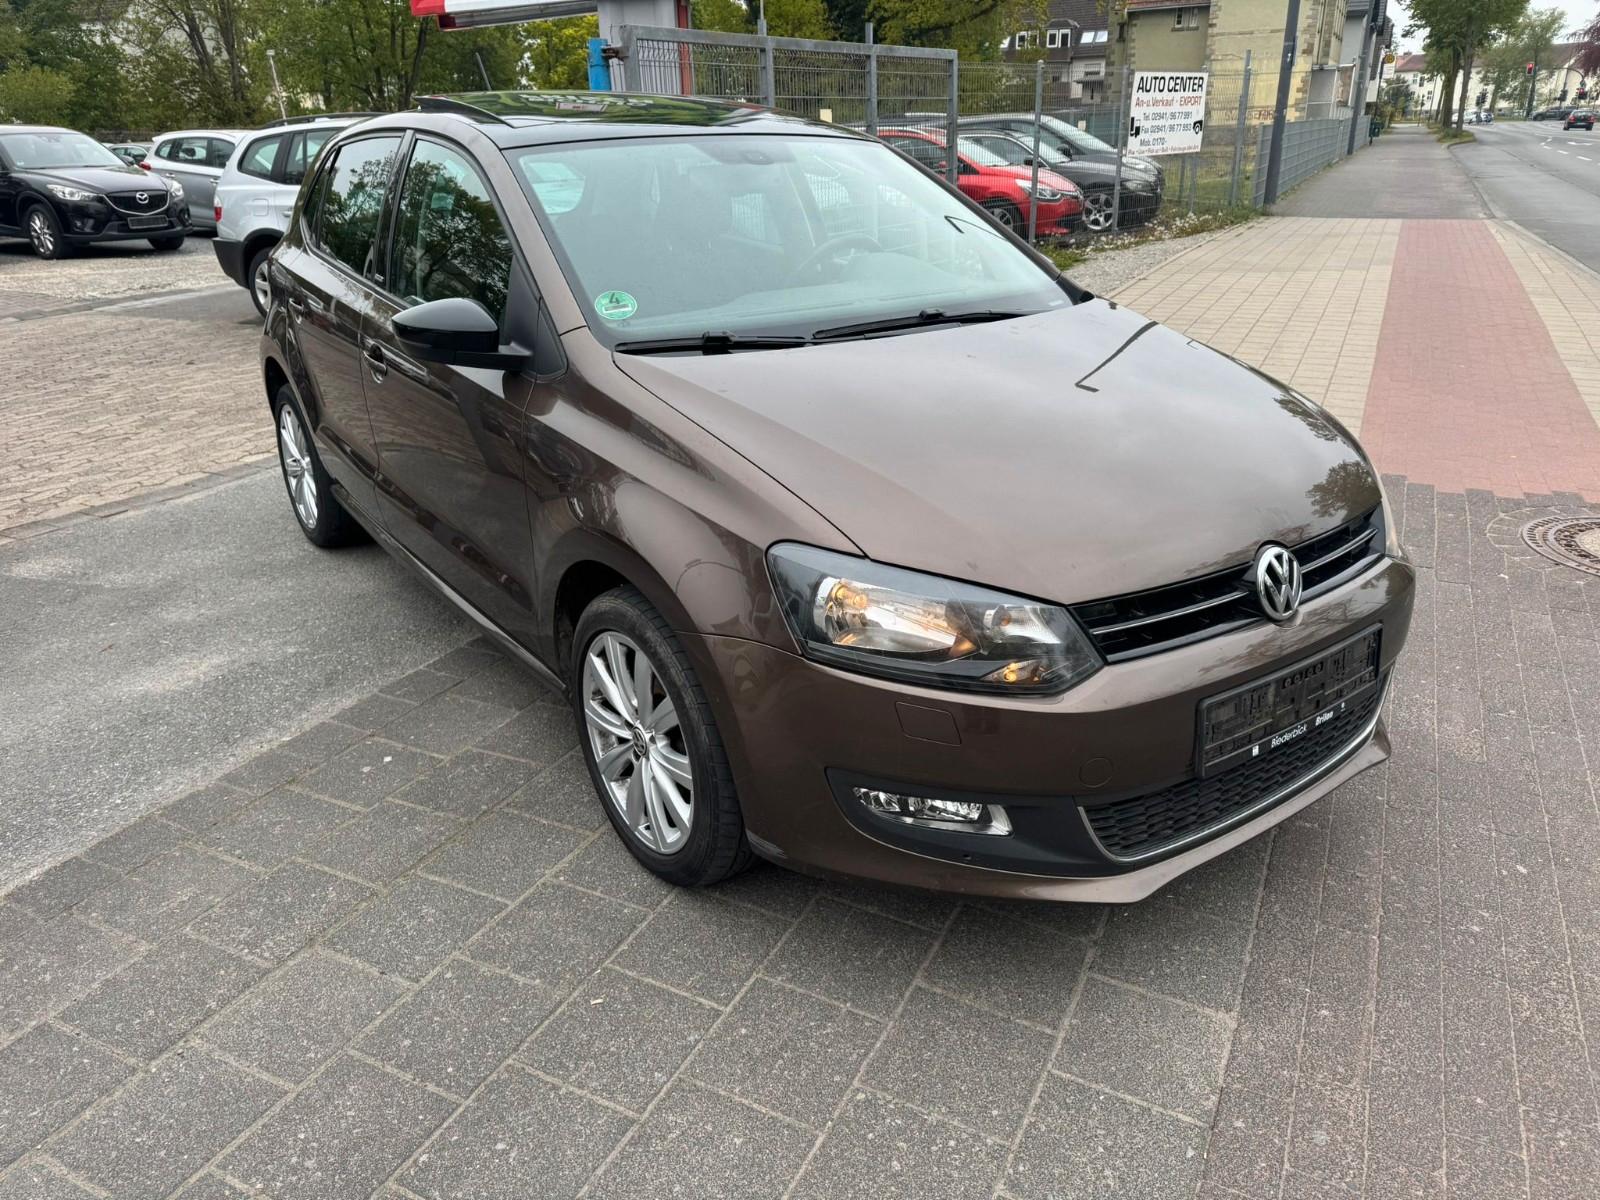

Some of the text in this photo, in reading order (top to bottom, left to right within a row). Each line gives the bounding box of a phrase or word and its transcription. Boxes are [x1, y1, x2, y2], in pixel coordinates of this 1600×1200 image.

[1137, 76, 1204, 93] AUTO CENTER
[1151, 96, 1175, 107] Verkauf
[1180, 96, 1202, 106] EXPORT
[608, 292, 620, 304] 4
